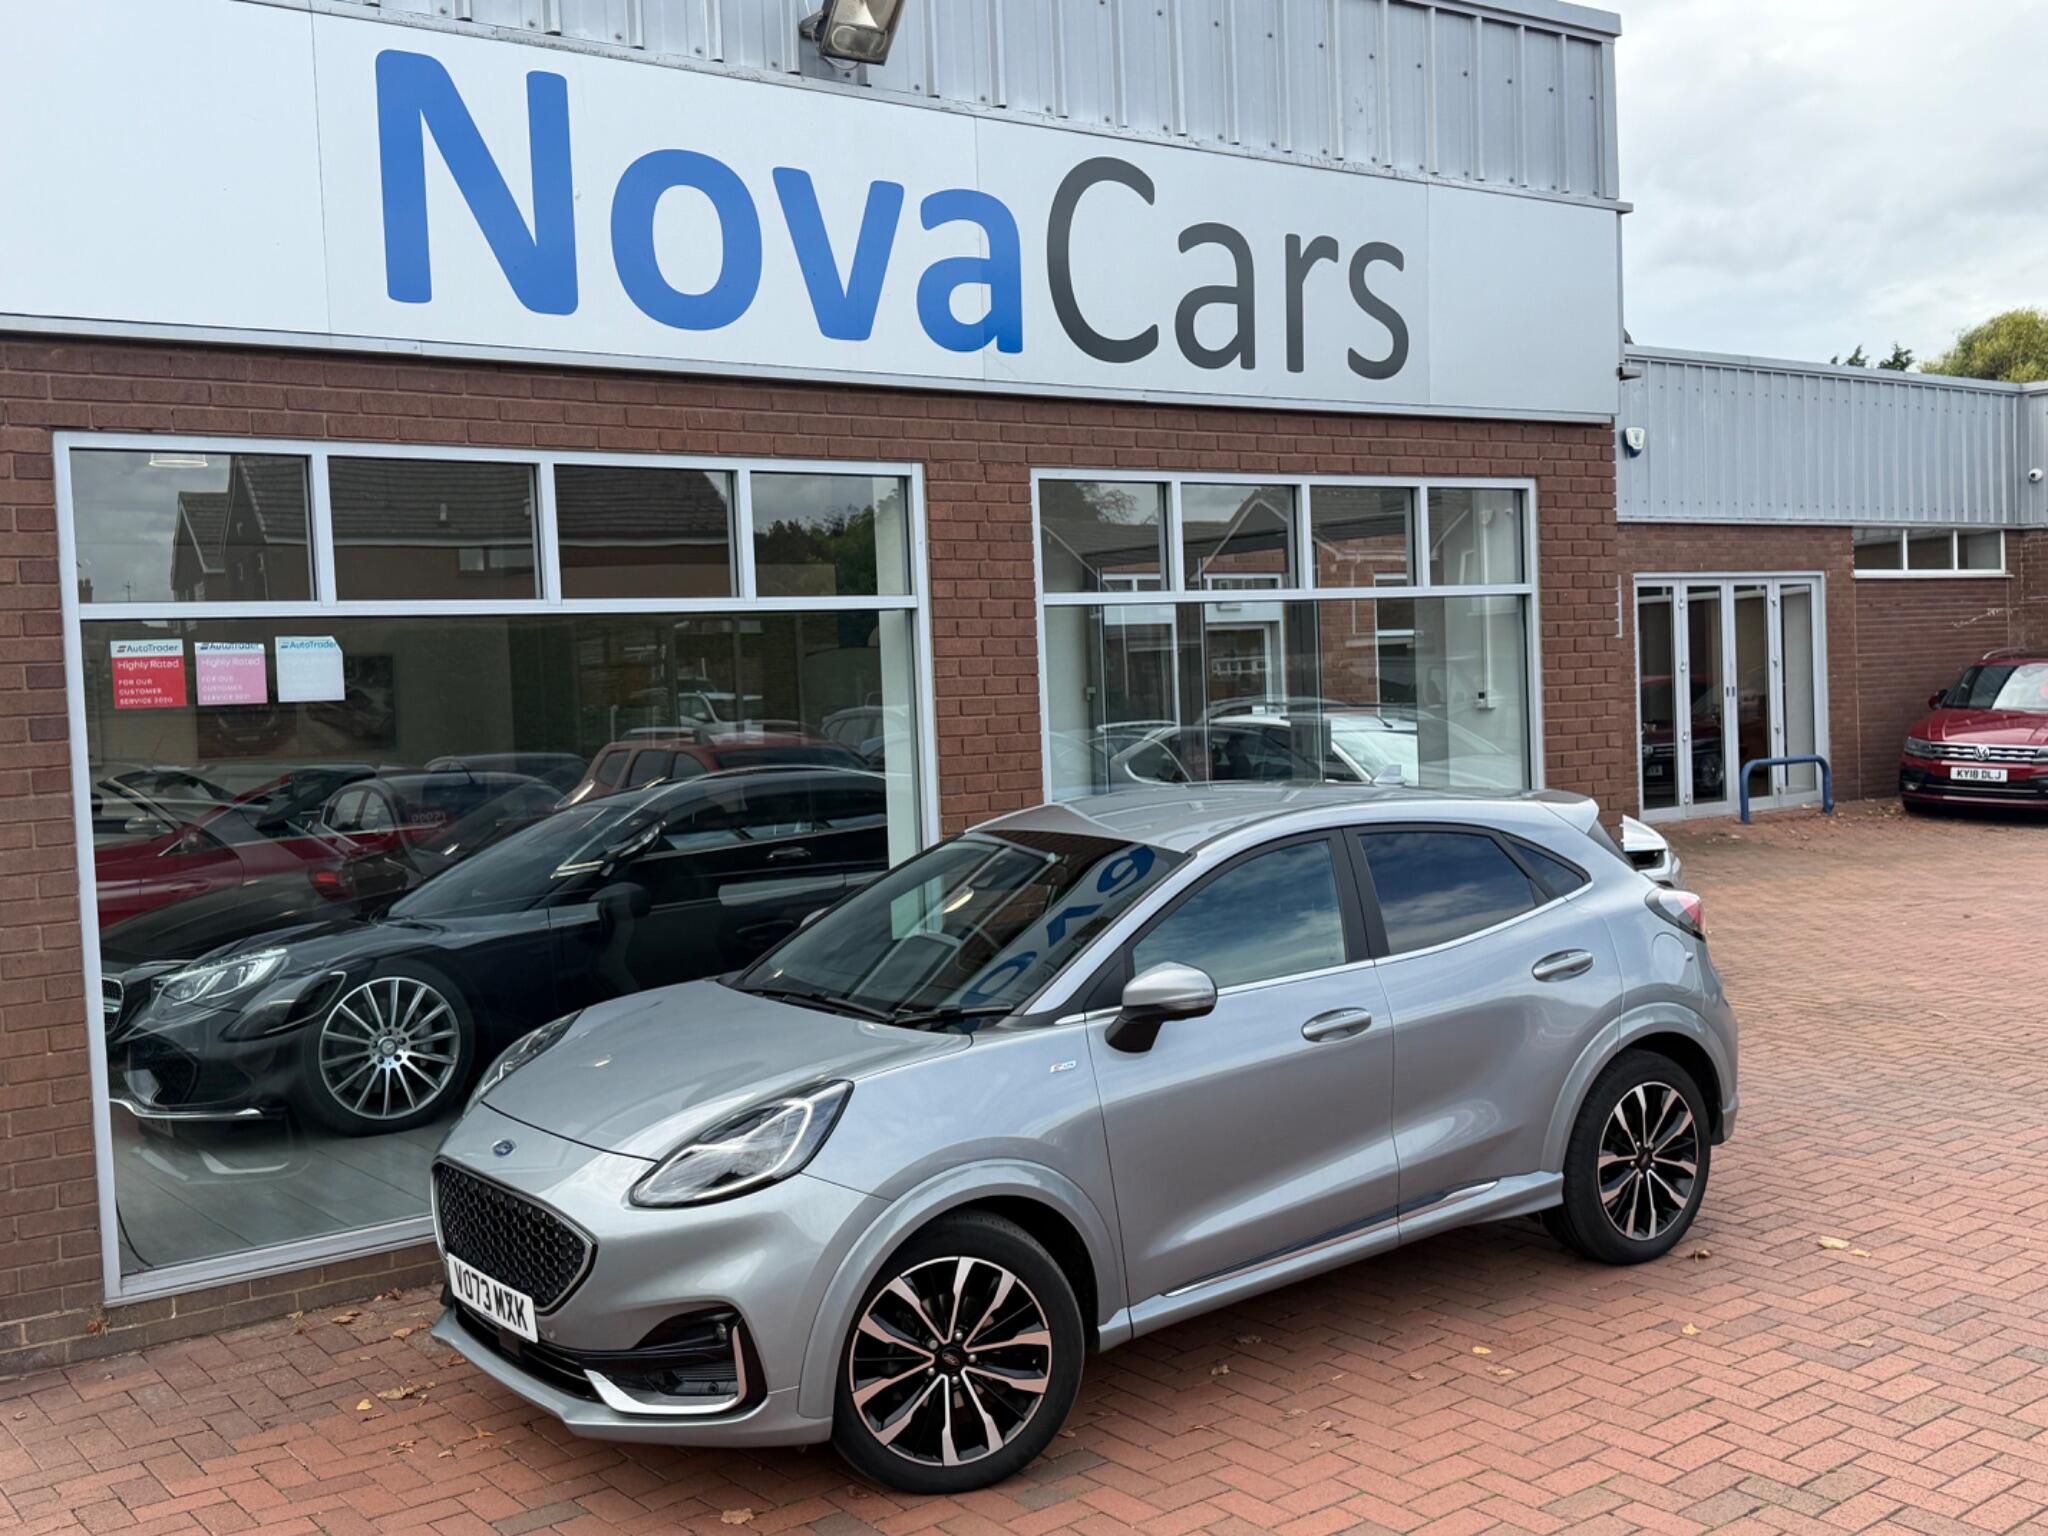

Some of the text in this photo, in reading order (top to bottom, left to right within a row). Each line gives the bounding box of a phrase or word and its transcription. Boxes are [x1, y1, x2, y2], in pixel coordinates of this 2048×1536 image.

[127, 644, 178, 653] AutoTrader
[117, 659, 179, 671] Highly Rated
[1956, 769, 2002, 779] KY18 DLJ
[493, 1284, 529, 1332] MXK
